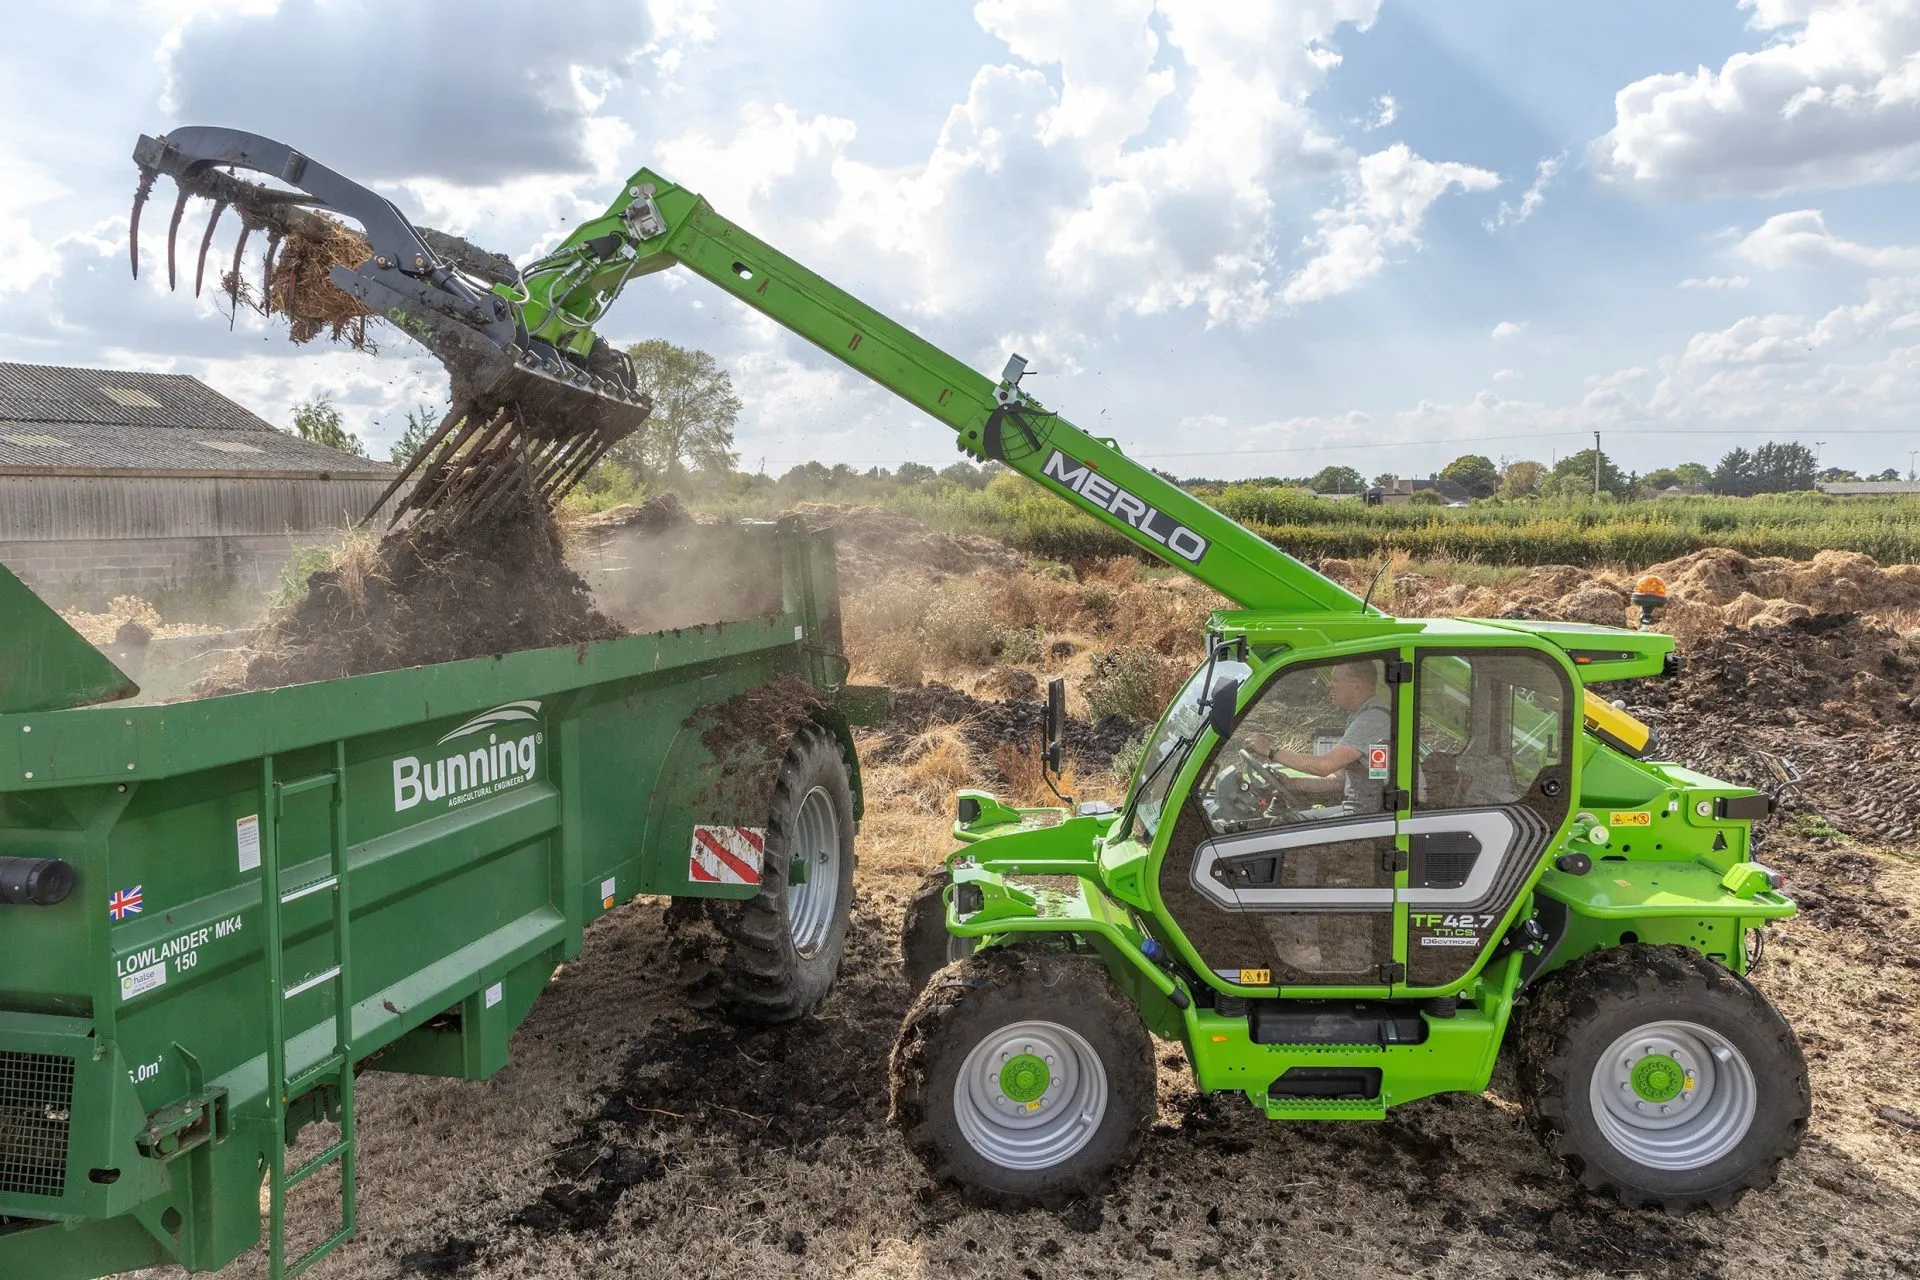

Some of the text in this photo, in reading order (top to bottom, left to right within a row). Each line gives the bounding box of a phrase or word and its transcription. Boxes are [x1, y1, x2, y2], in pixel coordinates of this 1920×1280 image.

[848, 333, 864, 351] B
[1044, 451, 1206, 561] MERLO
[448, 776, 524, 807] AGRICULTURAL ENGINEERS
[215, 915, 242, 939] MK4
[1410, 914, 1495, 928] TF42.7
[174, 951, 197, 973] 150
[133, 970, 155, 985] halse
